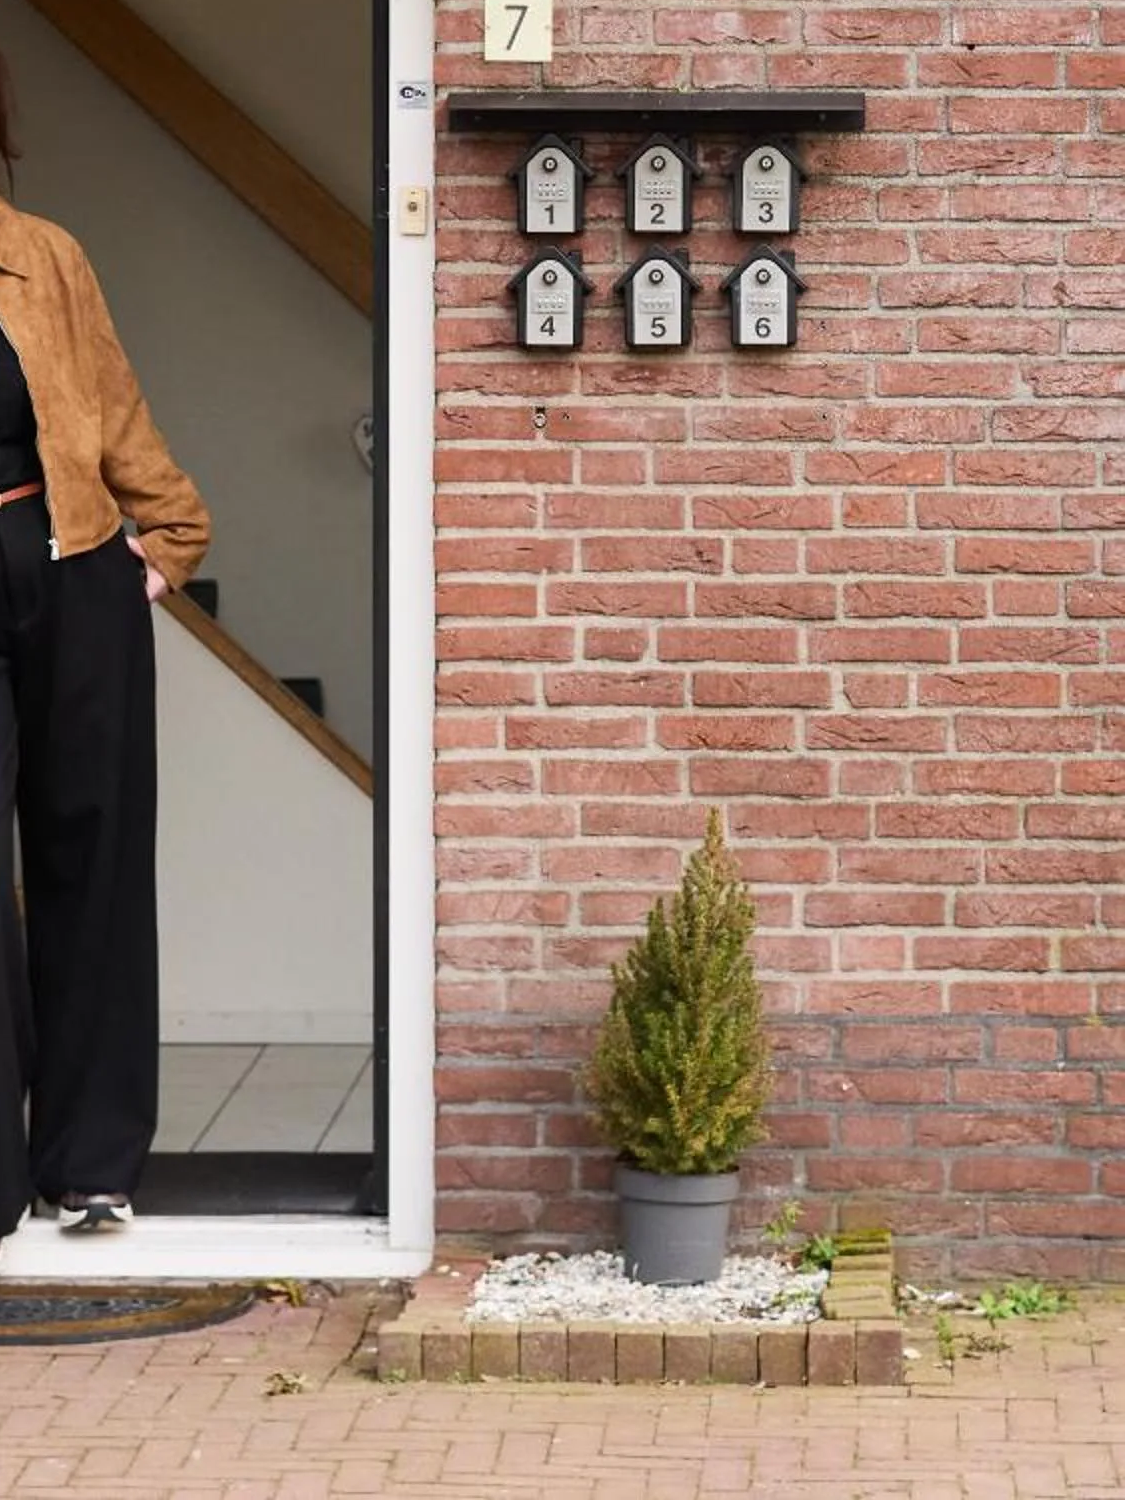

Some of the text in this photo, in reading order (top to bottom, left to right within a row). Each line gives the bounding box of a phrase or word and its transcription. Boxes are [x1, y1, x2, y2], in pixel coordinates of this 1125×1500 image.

[503, 4, 529, 51] 7
[543, 203, 556, 226] 1
[649, 202, 666, 225] 2
[757, 201, 775, 224] 3
[539, 316, 556, 337] 4
[650, 316, 667, 338] 5
[754, 316, 771, 338] 6
